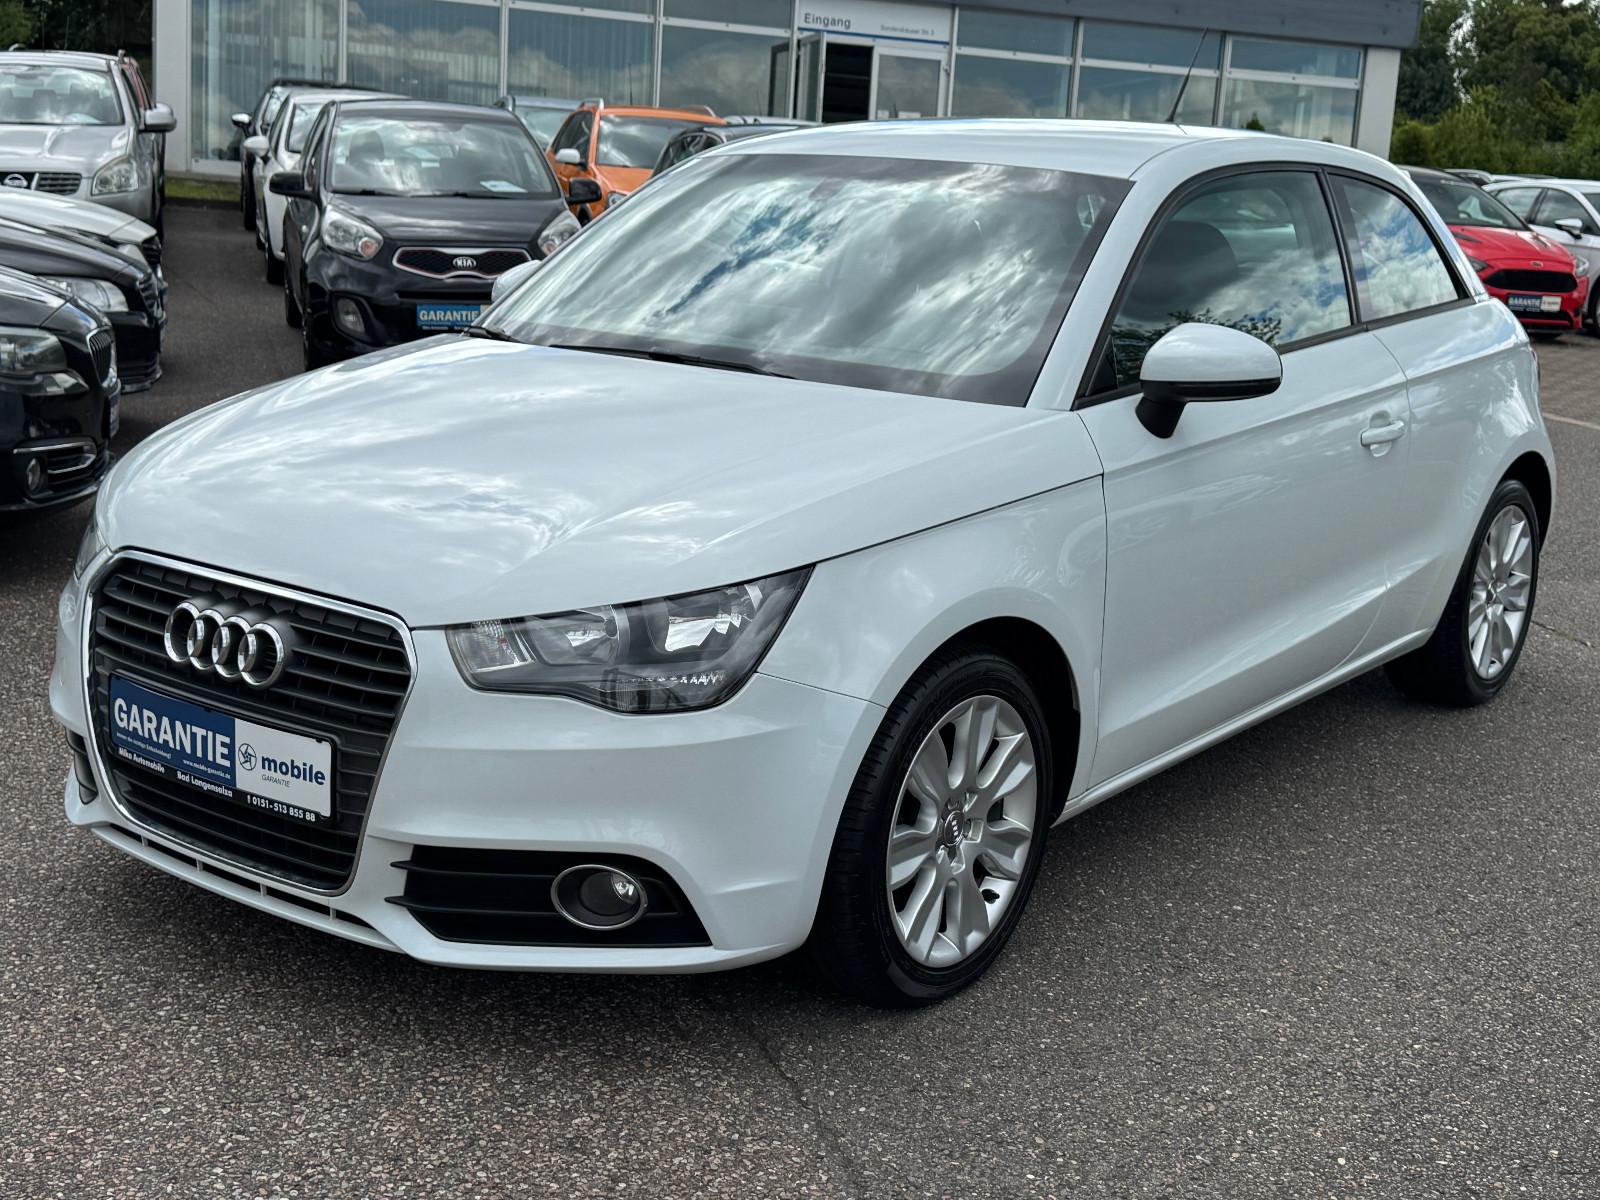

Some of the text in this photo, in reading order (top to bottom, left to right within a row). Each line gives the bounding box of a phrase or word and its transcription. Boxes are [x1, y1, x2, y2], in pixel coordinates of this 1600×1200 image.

[804, 12, 851, 29] Eingang
[419, 310, 479, 321] GARANTIE
[114, 698, 231, 768] GARANTIE
[132, 753, 165, 773] Automobile
[261, 756, 326, 786] mobile
[176, 770, 233, 797] Bad Langensalza
[261, 774, 291, 787] GARANTIE
[289, 807, 304, 819] 855
[305, 811, 316, 822] 88
